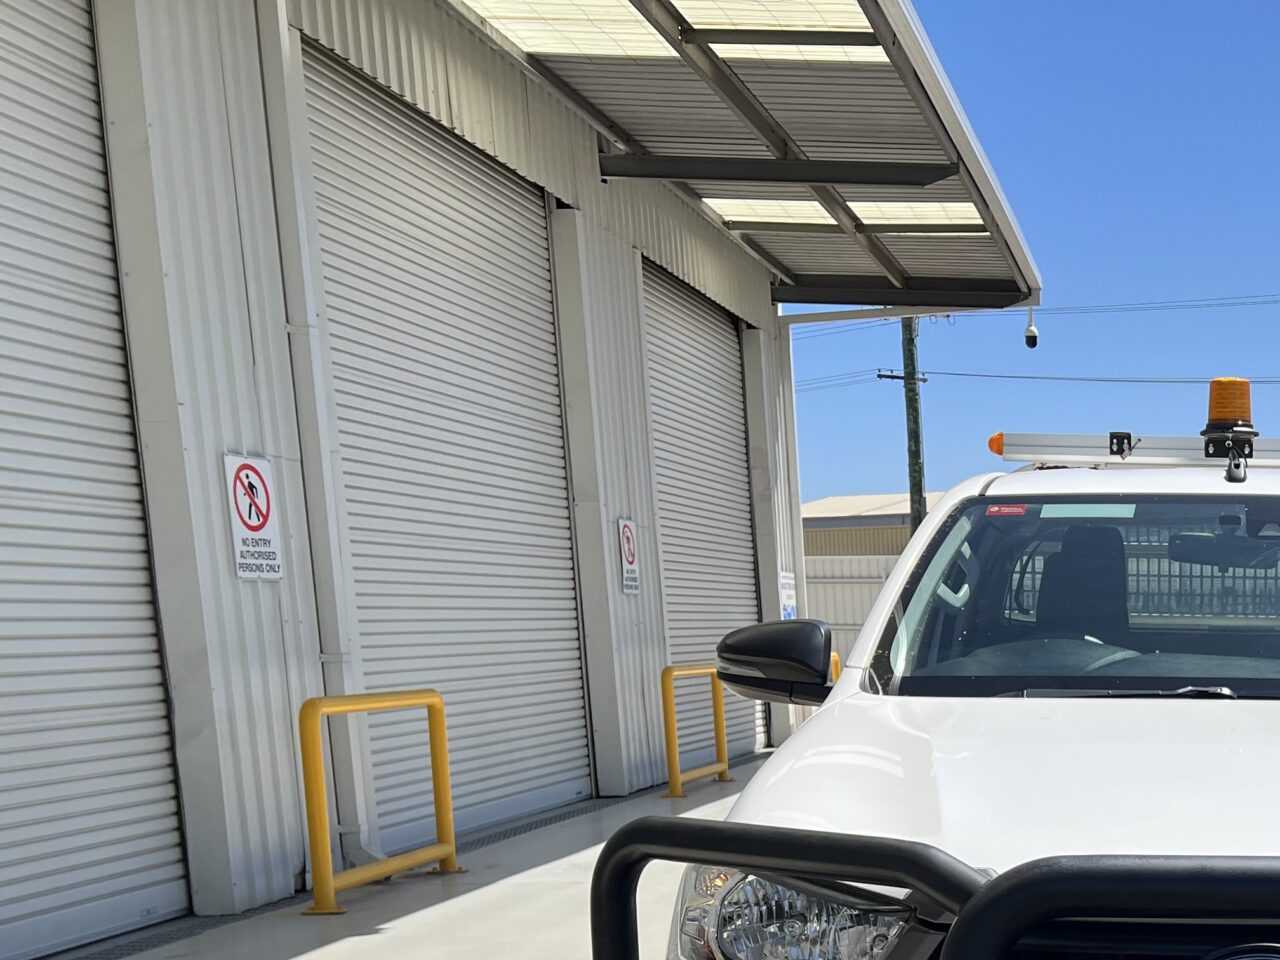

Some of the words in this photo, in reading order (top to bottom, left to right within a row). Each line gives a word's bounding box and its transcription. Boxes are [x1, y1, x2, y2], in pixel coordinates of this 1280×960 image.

[241, 537, 250, 547] NO
[251, 537, 271, 548] ENTRY
[240, 550, 277, 561] AUTHORISED
[238, 562, 265, 573] PERSONS
[265, 563, 280, 573] ONLY
